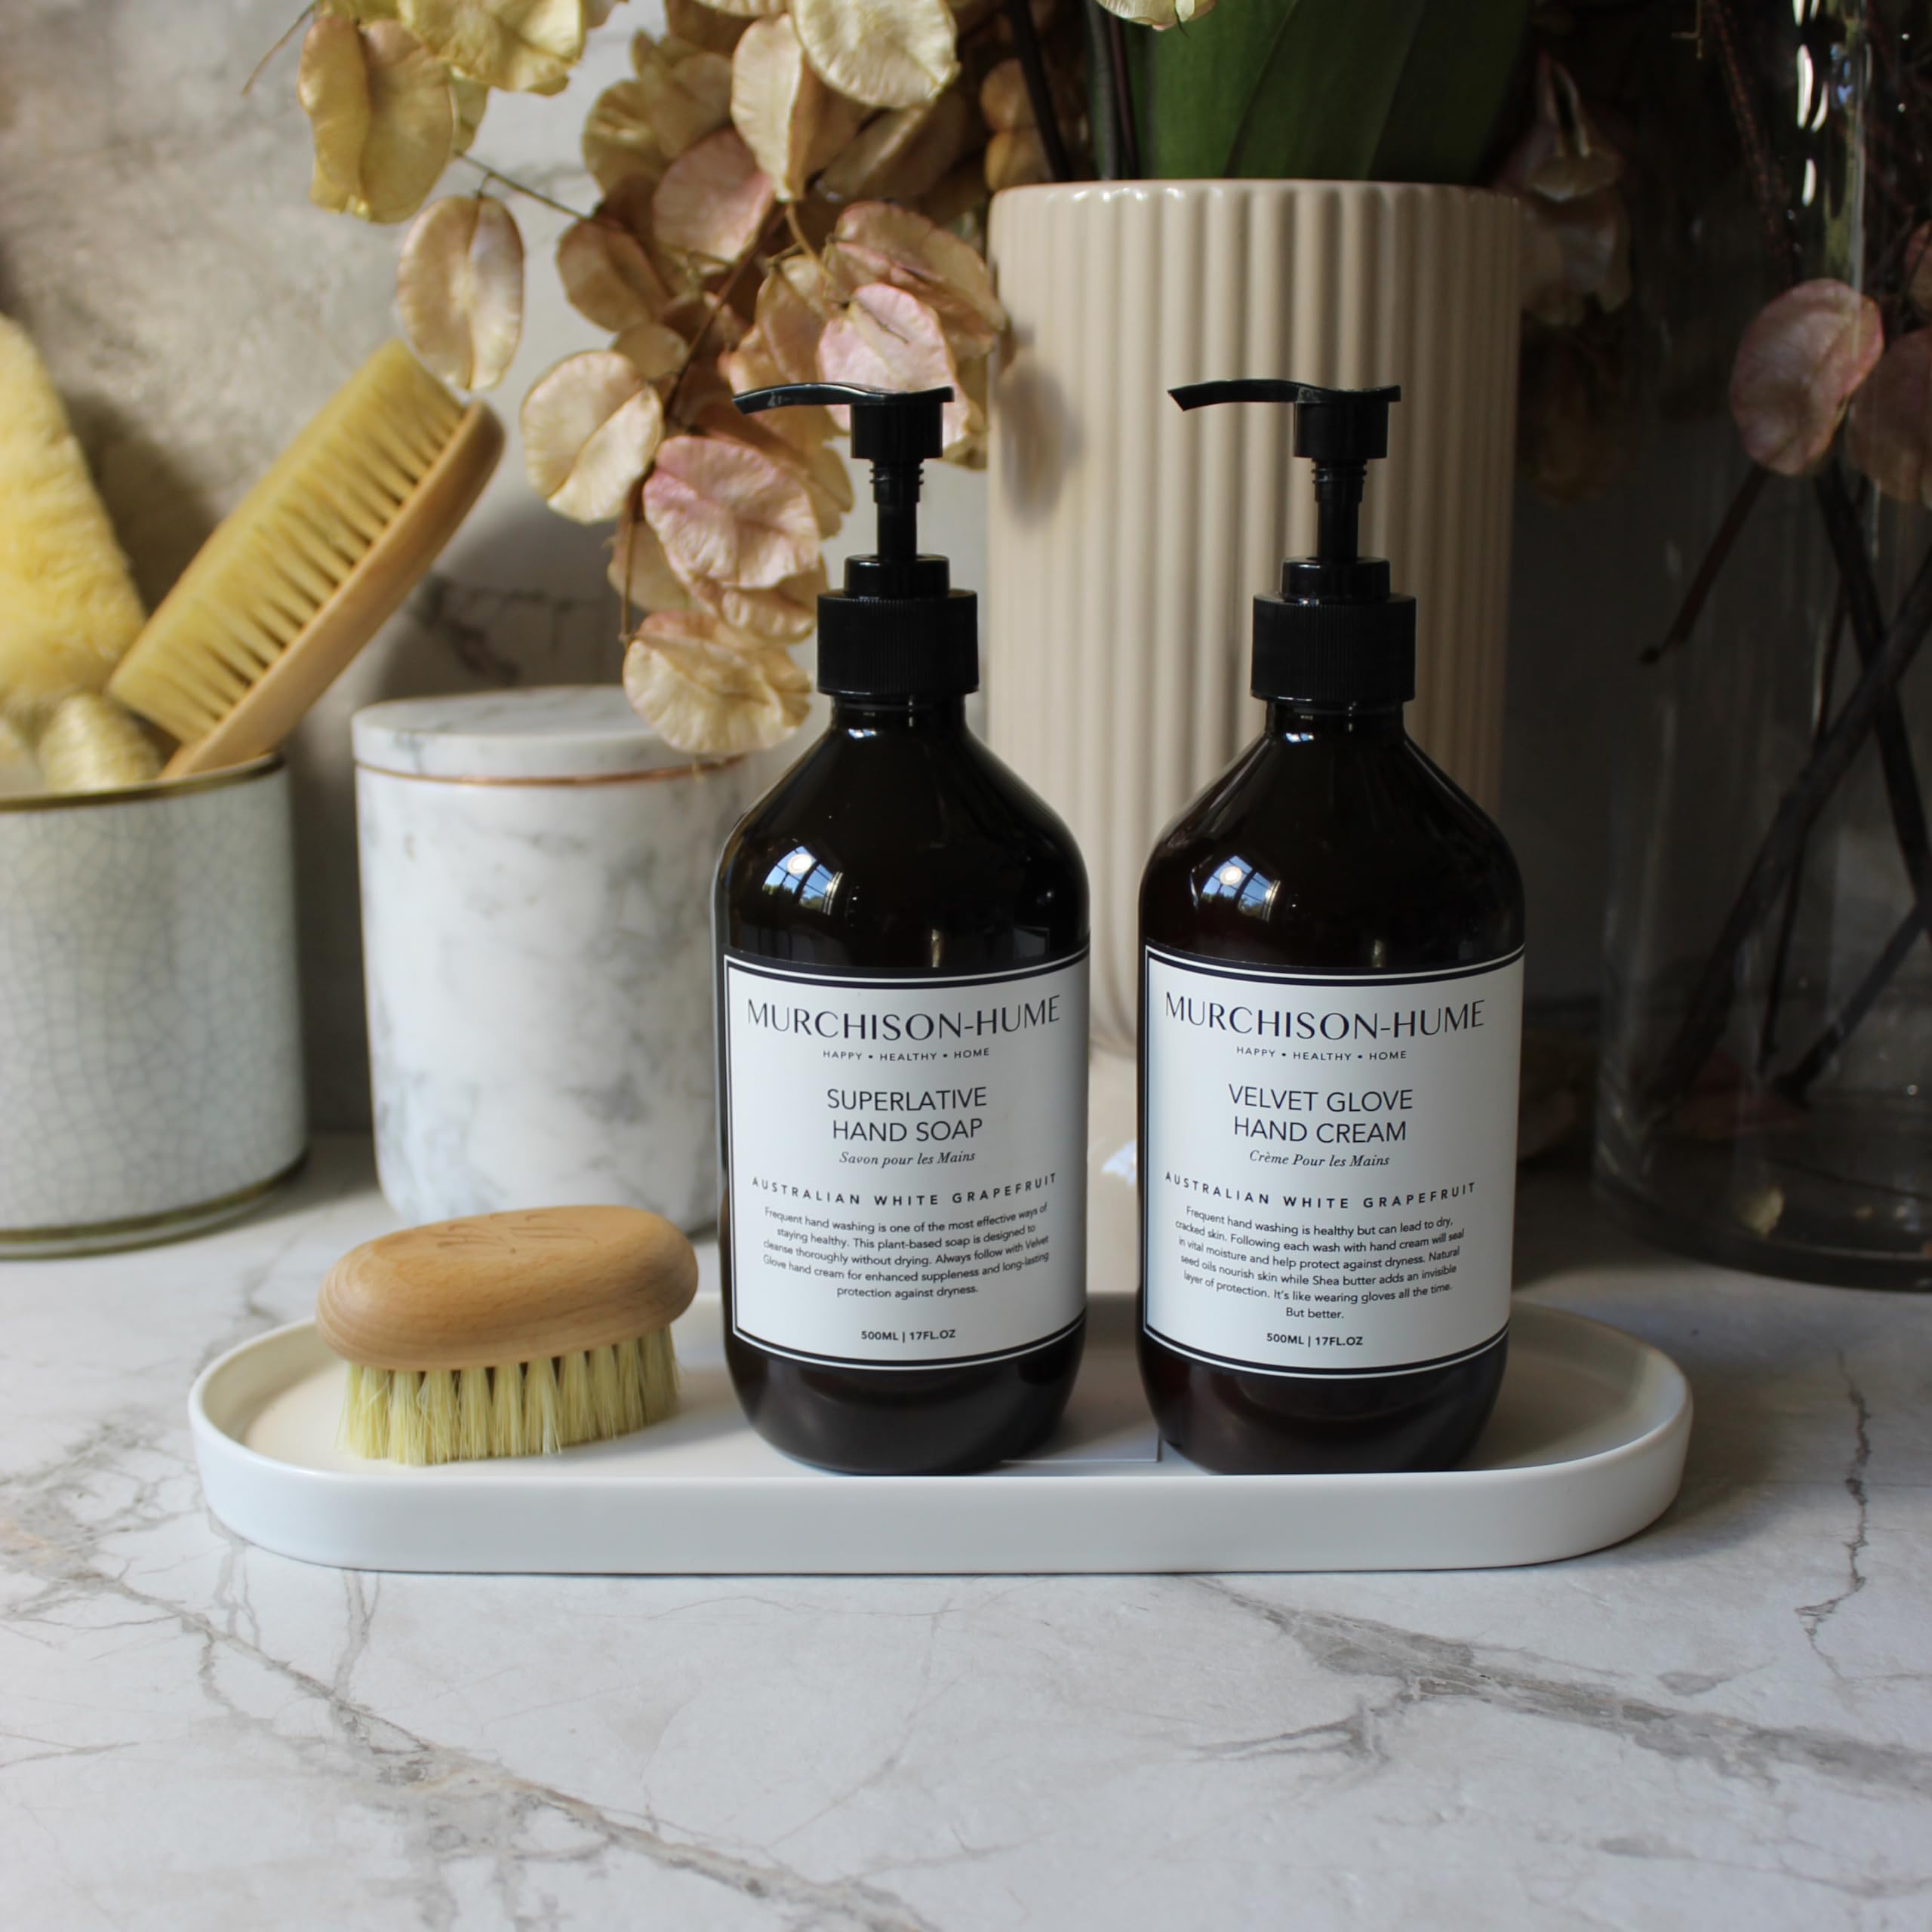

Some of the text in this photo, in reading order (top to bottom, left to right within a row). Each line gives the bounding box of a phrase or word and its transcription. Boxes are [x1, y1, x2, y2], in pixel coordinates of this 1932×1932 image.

[748, 995, 1060, 1041] MURCHISON-HUME
[1166, 991, 1484, 1041] MURCHISON-HUME
[823, 1048, 989, 1061] HAPPY HEALTHY HOME
[1236, 1046, 1406, 1061] HAPPY HEALTHY HOME
[827, 1086, 987, 1112] SUPERLATIVE
[1228, 1083, 1413, 1112] VELVET GLOVE
[833, 1118, 983, 1142] HAND SOAP
[1234, 1115, 1406, 1143] HAND CREAM
[839, 1150, 976, 1169] Savon pour les Mains
[1250, 1149, 1389, 1167] Crème Pour les Mains
[752, 1173, 1055, 1206] AUSTRALIAN WHITE GRAPEFRUIT
[1165, 1171, 1475, 1209] AUSTRALIAN WHITE GRAPEFRUIT
[765, 1207, 803, 1224] Frequent
[804, 1216, 829, 1229] hand
[832, 1221, 875, 1235] washing
[878, 1223, 887, 1232] is
[913, 1221, 925, 1232] of
[928, 1221, 946, 1232] the
[948, 1220, 974, 1230] most
[977, 1214, 1017, 1227] effective
[1018, 1208, 1038, 1219] ways
[1039, 1201, 1047, 1213] of
[1186, 1205, 1453, 1238] Frequent hand washing is healthy but can lead to dry,
[777, 1225, 1035, 1252] staying healthy. This plant-based soap is designed to
[1175, 1220, 1464, 1253] cracked skin. Following each wash with hand cream will seal
[763, 1235, 1049, 1268] cleanse thoroughly without drying. Always follow with Velvet
[1179, 1237, 1460, 1272] in vital moisture and help protect against dryness. Natural
[763, 1252, 1049, 1284] Glove hand cream for enhanced suppleness and long-lasting
[1181, 1255, 1457, 1286] seed oils nourish skin while Shea butter adds an invisible
[837, 1286, 978, 1300] protection against dryness.
[1184, 1270, 1203, 1284] layer
[1204, 1278, 1214, 1287] of
[1216, 1282, 1270, 1298] protection.
[1292, 1290, 1312, 1302] like
[1314, 1293, 1358, 1305] wearing
[1361, 1291, 1396, 1304] gloves
[1398, 1287, 1410, 1299] all
[1412, 1287, 1428, 1297] the
[1430, 1284, 1452, 1294] time.
[1286, 1306, 1344, 1319] But better.
[861, 1331, 899, 1341] 500ML
[909, 1329, 956, 1340] 17FL.OZ
[1266, 1333, 1305, 1345] 500ML
[1315, 1336, 1363, 1346] 17FL.OZ
